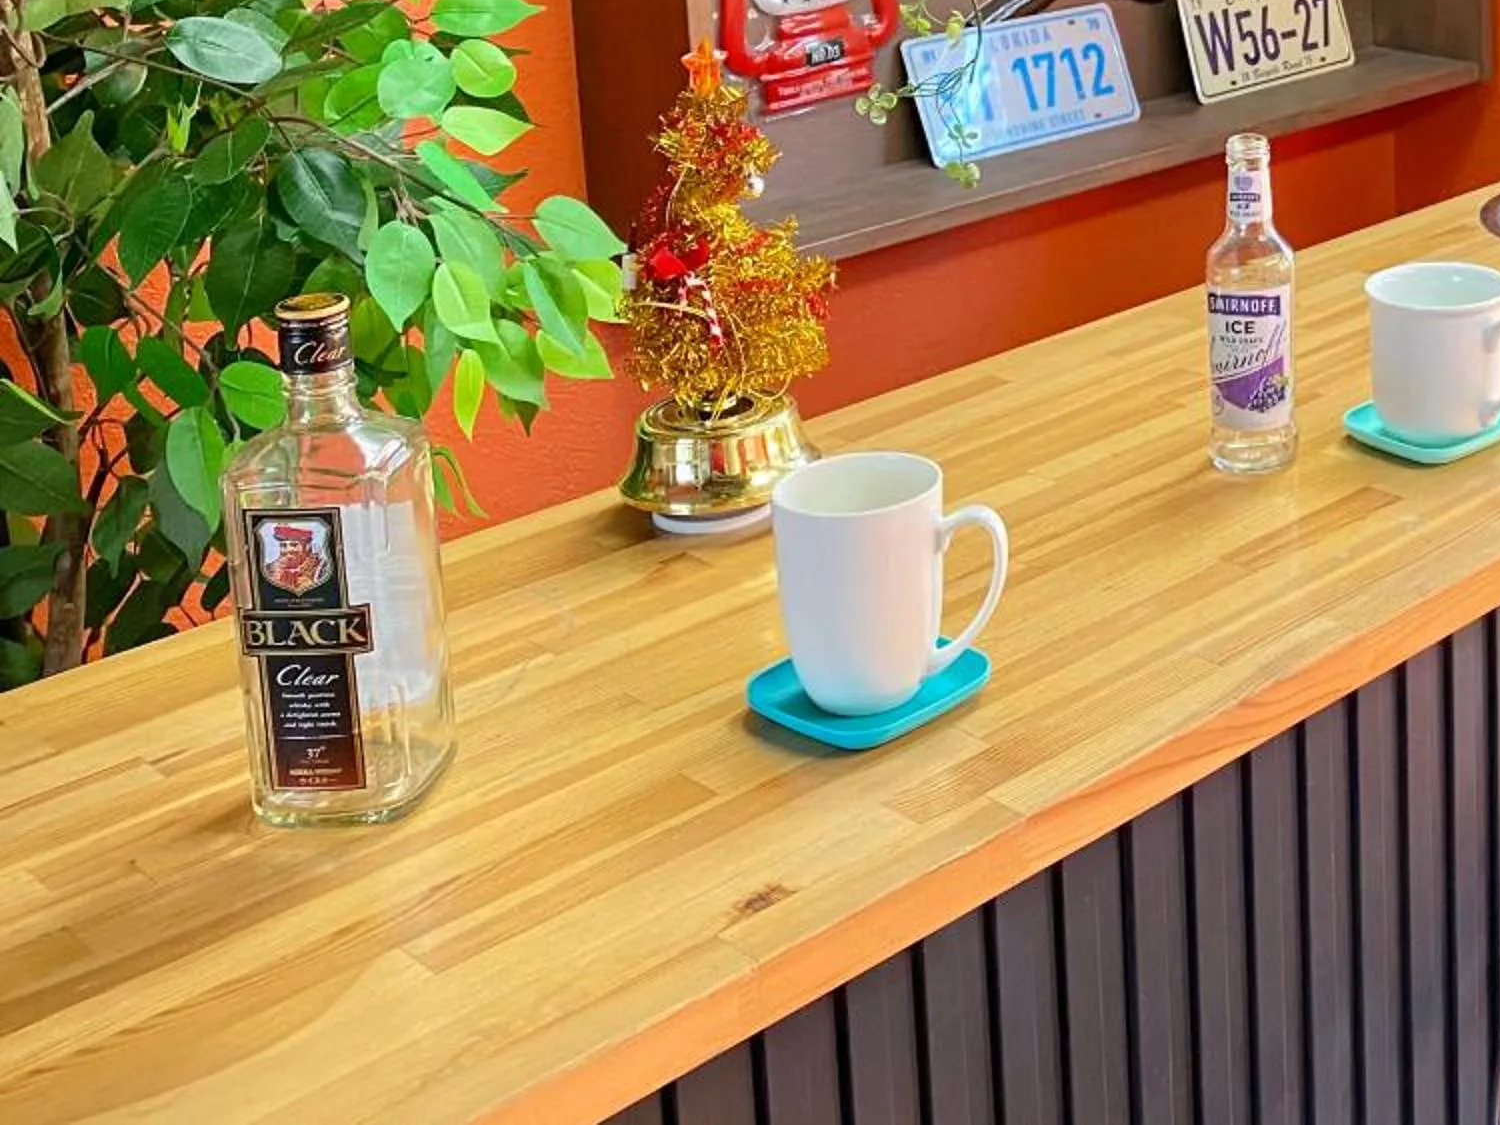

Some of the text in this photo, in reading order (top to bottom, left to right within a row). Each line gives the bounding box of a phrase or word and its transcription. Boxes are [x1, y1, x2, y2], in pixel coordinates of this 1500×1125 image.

[1010, 41, 1116, 113] 1712
[1225, 320, 1256, 335] ICE
[294, 340, 347, 366] Clear
[247, 615, 367, 648] BLACK
[276, 663, 340, 687] Clear
